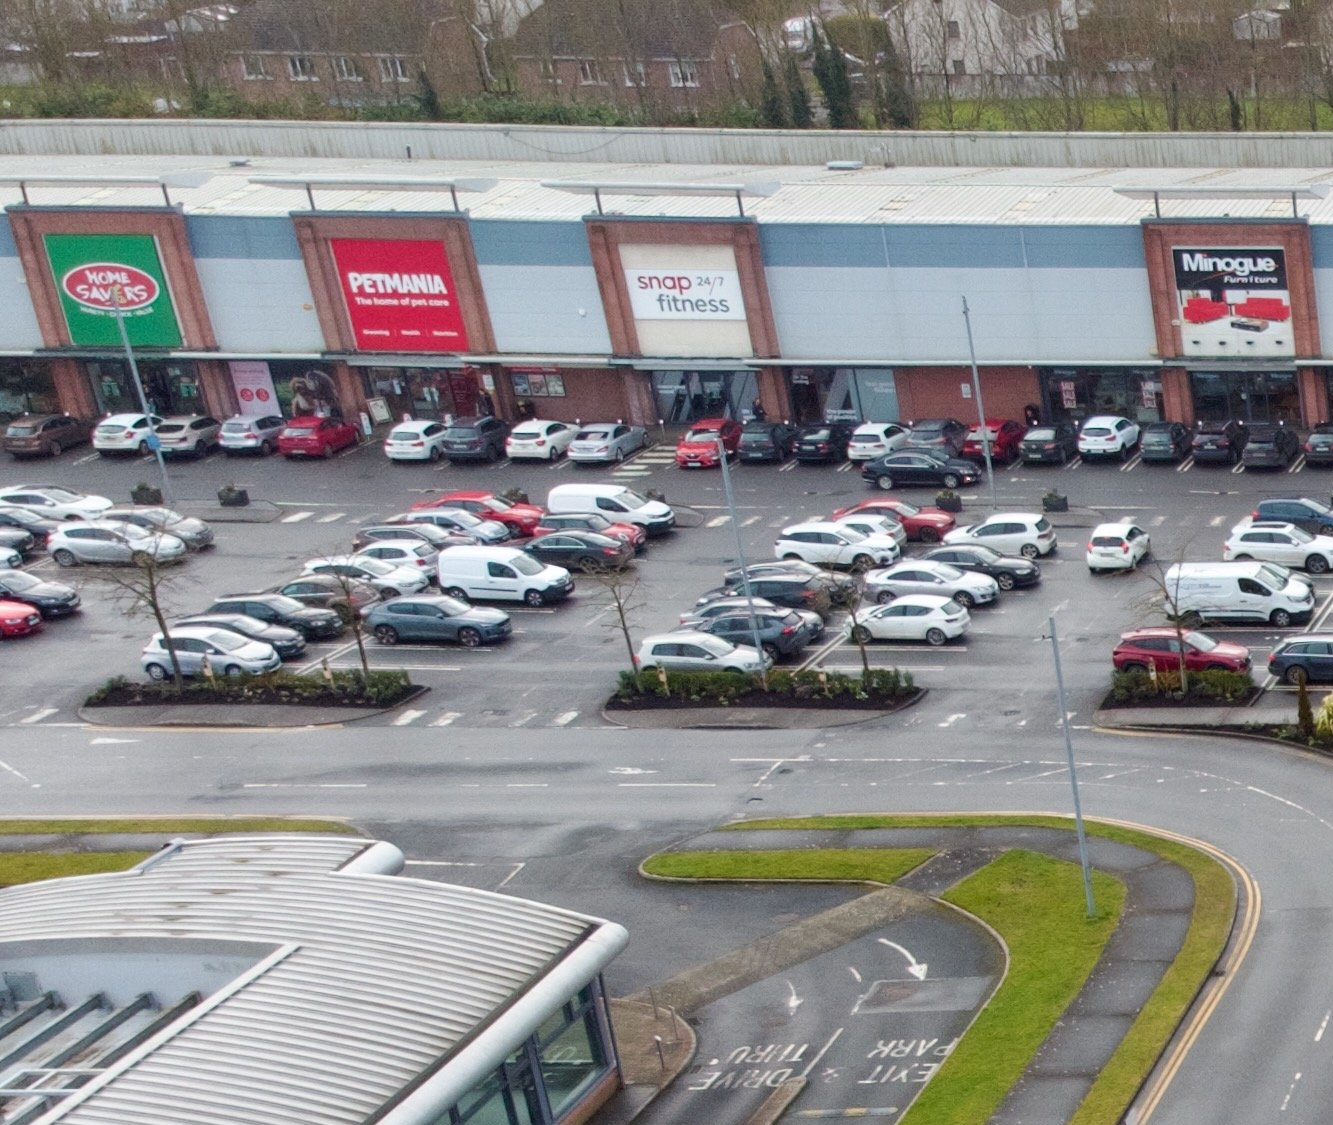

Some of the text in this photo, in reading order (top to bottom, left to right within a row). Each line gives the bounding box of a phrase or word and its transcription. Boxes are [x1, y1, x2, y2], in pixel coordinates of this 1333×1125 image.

[1182, 253, 1276, 276] Minogue
[85, 270, 131, 284] HOME
[348, 272, 448, 294] PETMANIA
[637, 275, 724, 295] snap 24/7
[1224, 276, 1278, 284] Furniture
[355, 297, 450, 308] The home of pet care
[657, 294, 730, 313] fitness
[727, 1043, 809, 1064] THRU
[867, 1037, 958, 1058] PARK
[688, 1067, 798, 1090] DRIVE
[858, 1062, 940, 1084] EXIT
